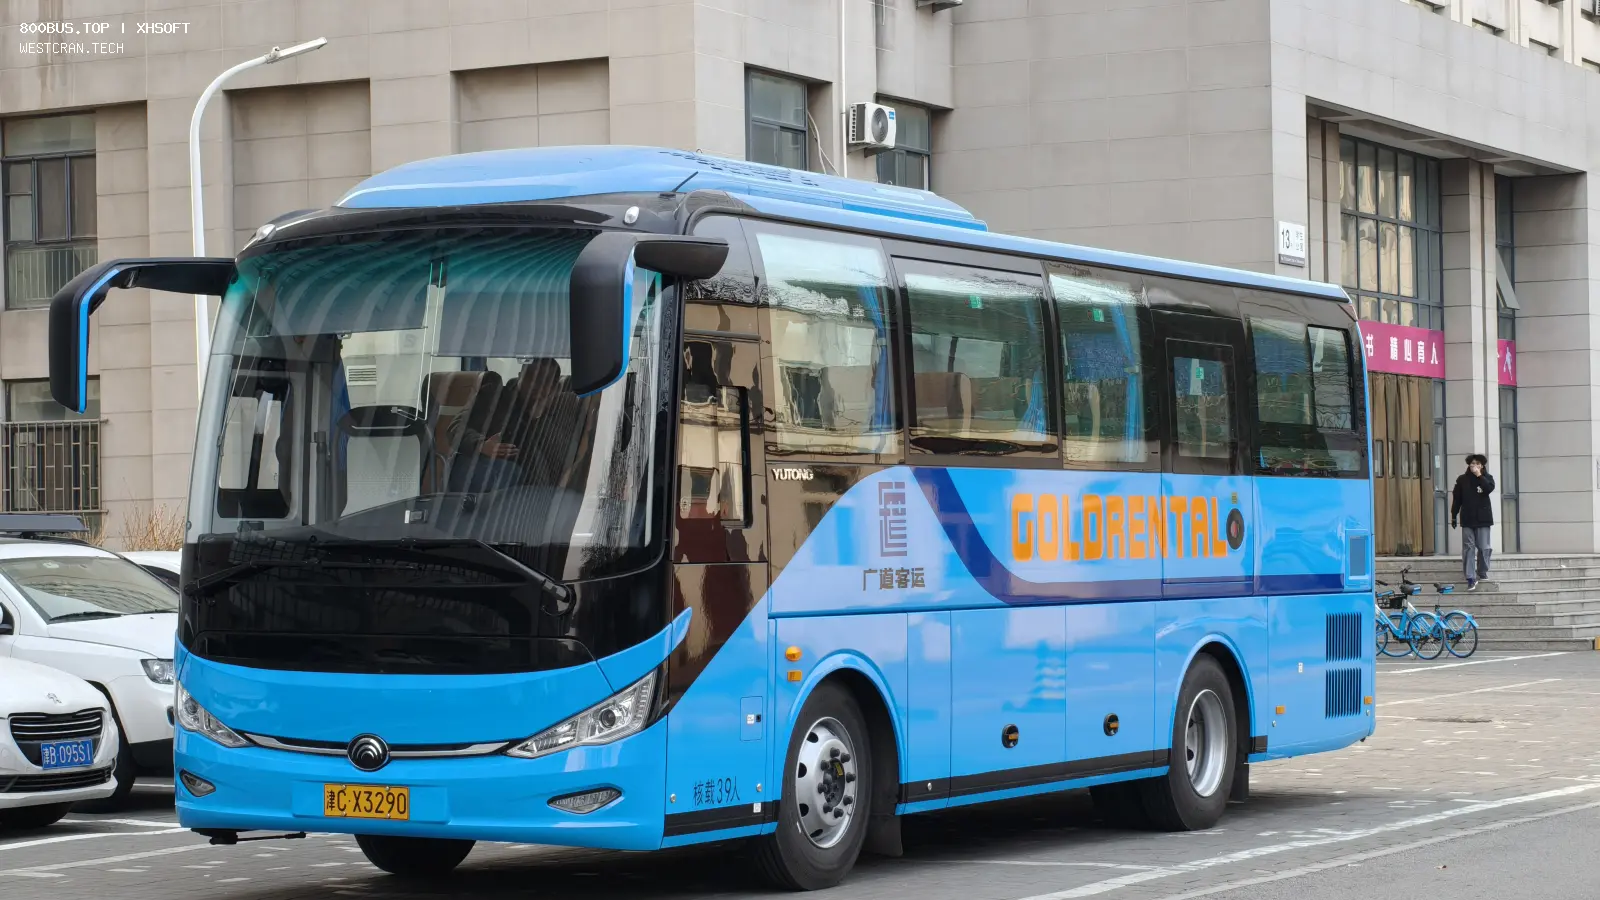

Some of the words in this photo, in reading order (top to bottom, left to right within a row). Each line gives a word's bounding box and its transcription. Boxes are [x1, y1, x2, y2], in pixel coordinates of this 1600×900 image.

[1281, 228, 1290, 249] 13
[771, 468, 814, 481] YUTONG
[1011, 492, 1229, 562] GOLDRENTAL
[862, 567, 926, 591] 广道客运
[693, 776, 741, 806] 核载39人
